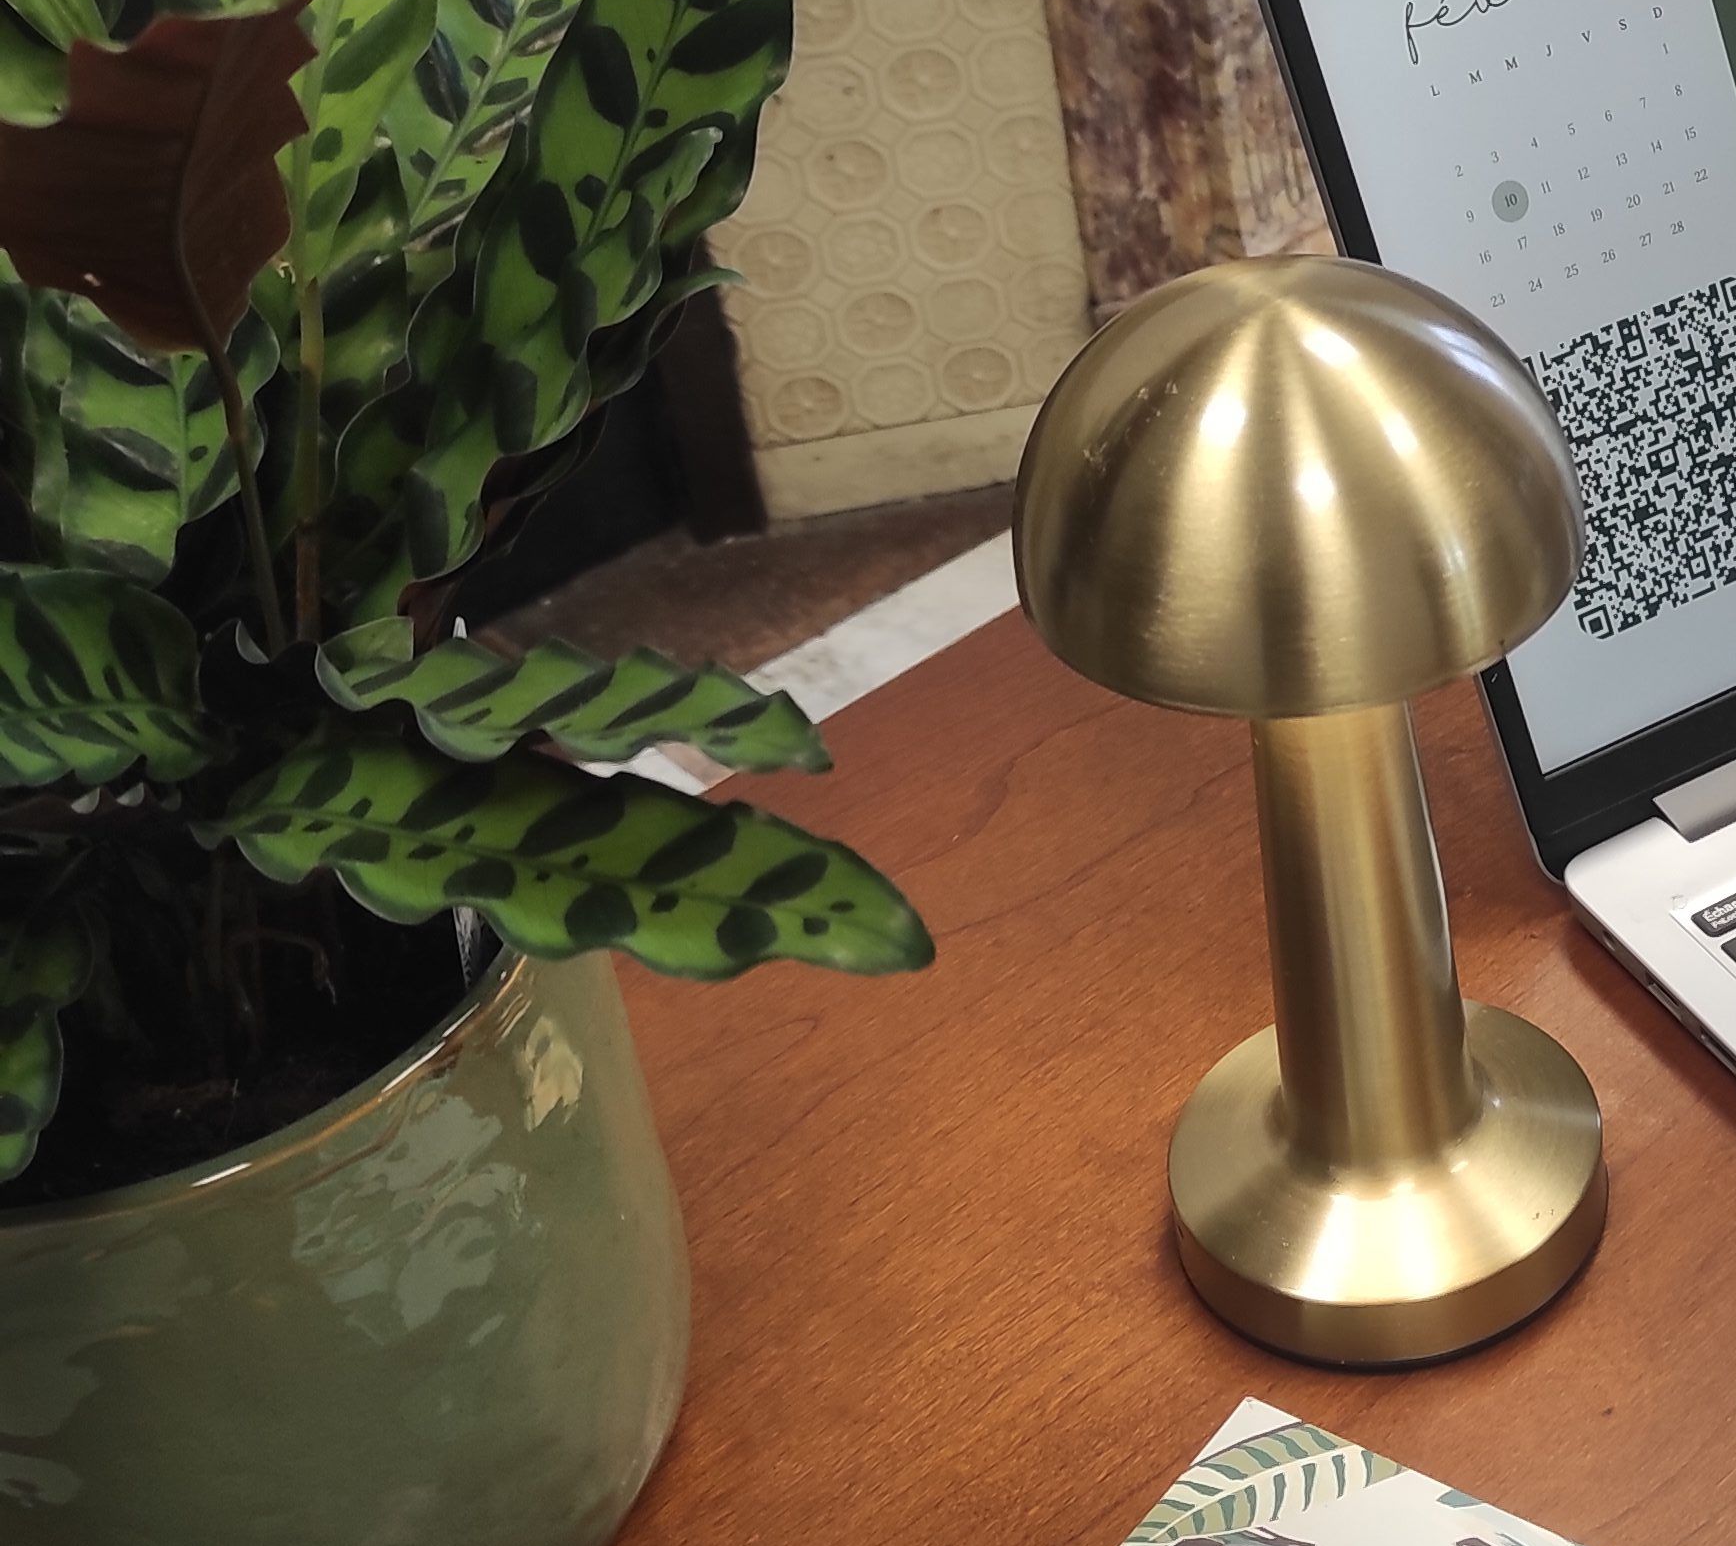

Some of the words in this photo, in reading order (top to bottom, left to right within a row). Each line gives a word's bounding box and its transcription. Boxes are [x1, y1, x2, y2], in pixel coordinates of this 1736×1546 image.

[1430, 85, 1440, 96] L
[1469, 70, 1482, 84] M
[1505, 56, 1518, 71] M
[1546, 45, 1551, 57] J
[1581, 30, 1590, 43] V
[1618, 19, 1627, 30] S
[1652, 7, 1662, 19] D
[1663, 43, 1668, 54] 1
[1455, 165, 1464, 177] 2
[1491, 151, 1499, 163] 3
[1531, 137, 1538, 148] 4
[1567, 122, 1576, 136] 5
[1605, 110, 1613, 122] 6
[1639, 97, 1646, 109] 7
[1675, 84, 1683, 97] 8
[1466, 210, 1474, 223] 9
[1505, 193, 1517, 208] 10
[1541, 181, 1551, 194] 11
[1578, 167, 1590, 180] 12
[1616, 152, 1628, 167] 13
[1651, 140, 1662, 153] 14
[1685, 126, 1696, 141] 15
[1479, 250, 1492, 264] 16
[1517, 235, 1527, 250] 17
[1553, 222, 1565, 236] 18
[1590, 208, 1602, 222] 19
[1626, 194, 1641, 209] 20
[1662, 181, 1675, 195] 21
[1694, 168, 1708, 183] 22
[1490, 293, 1506, 308] 23
[1528, 278, 1542, 292] 24
[1564, 263, 1579, 279] 25
[1601, 249, 1616, 264] 26
[1639, 232, 1651, 247] 27
[1670, 220, 1684, 235] 28
